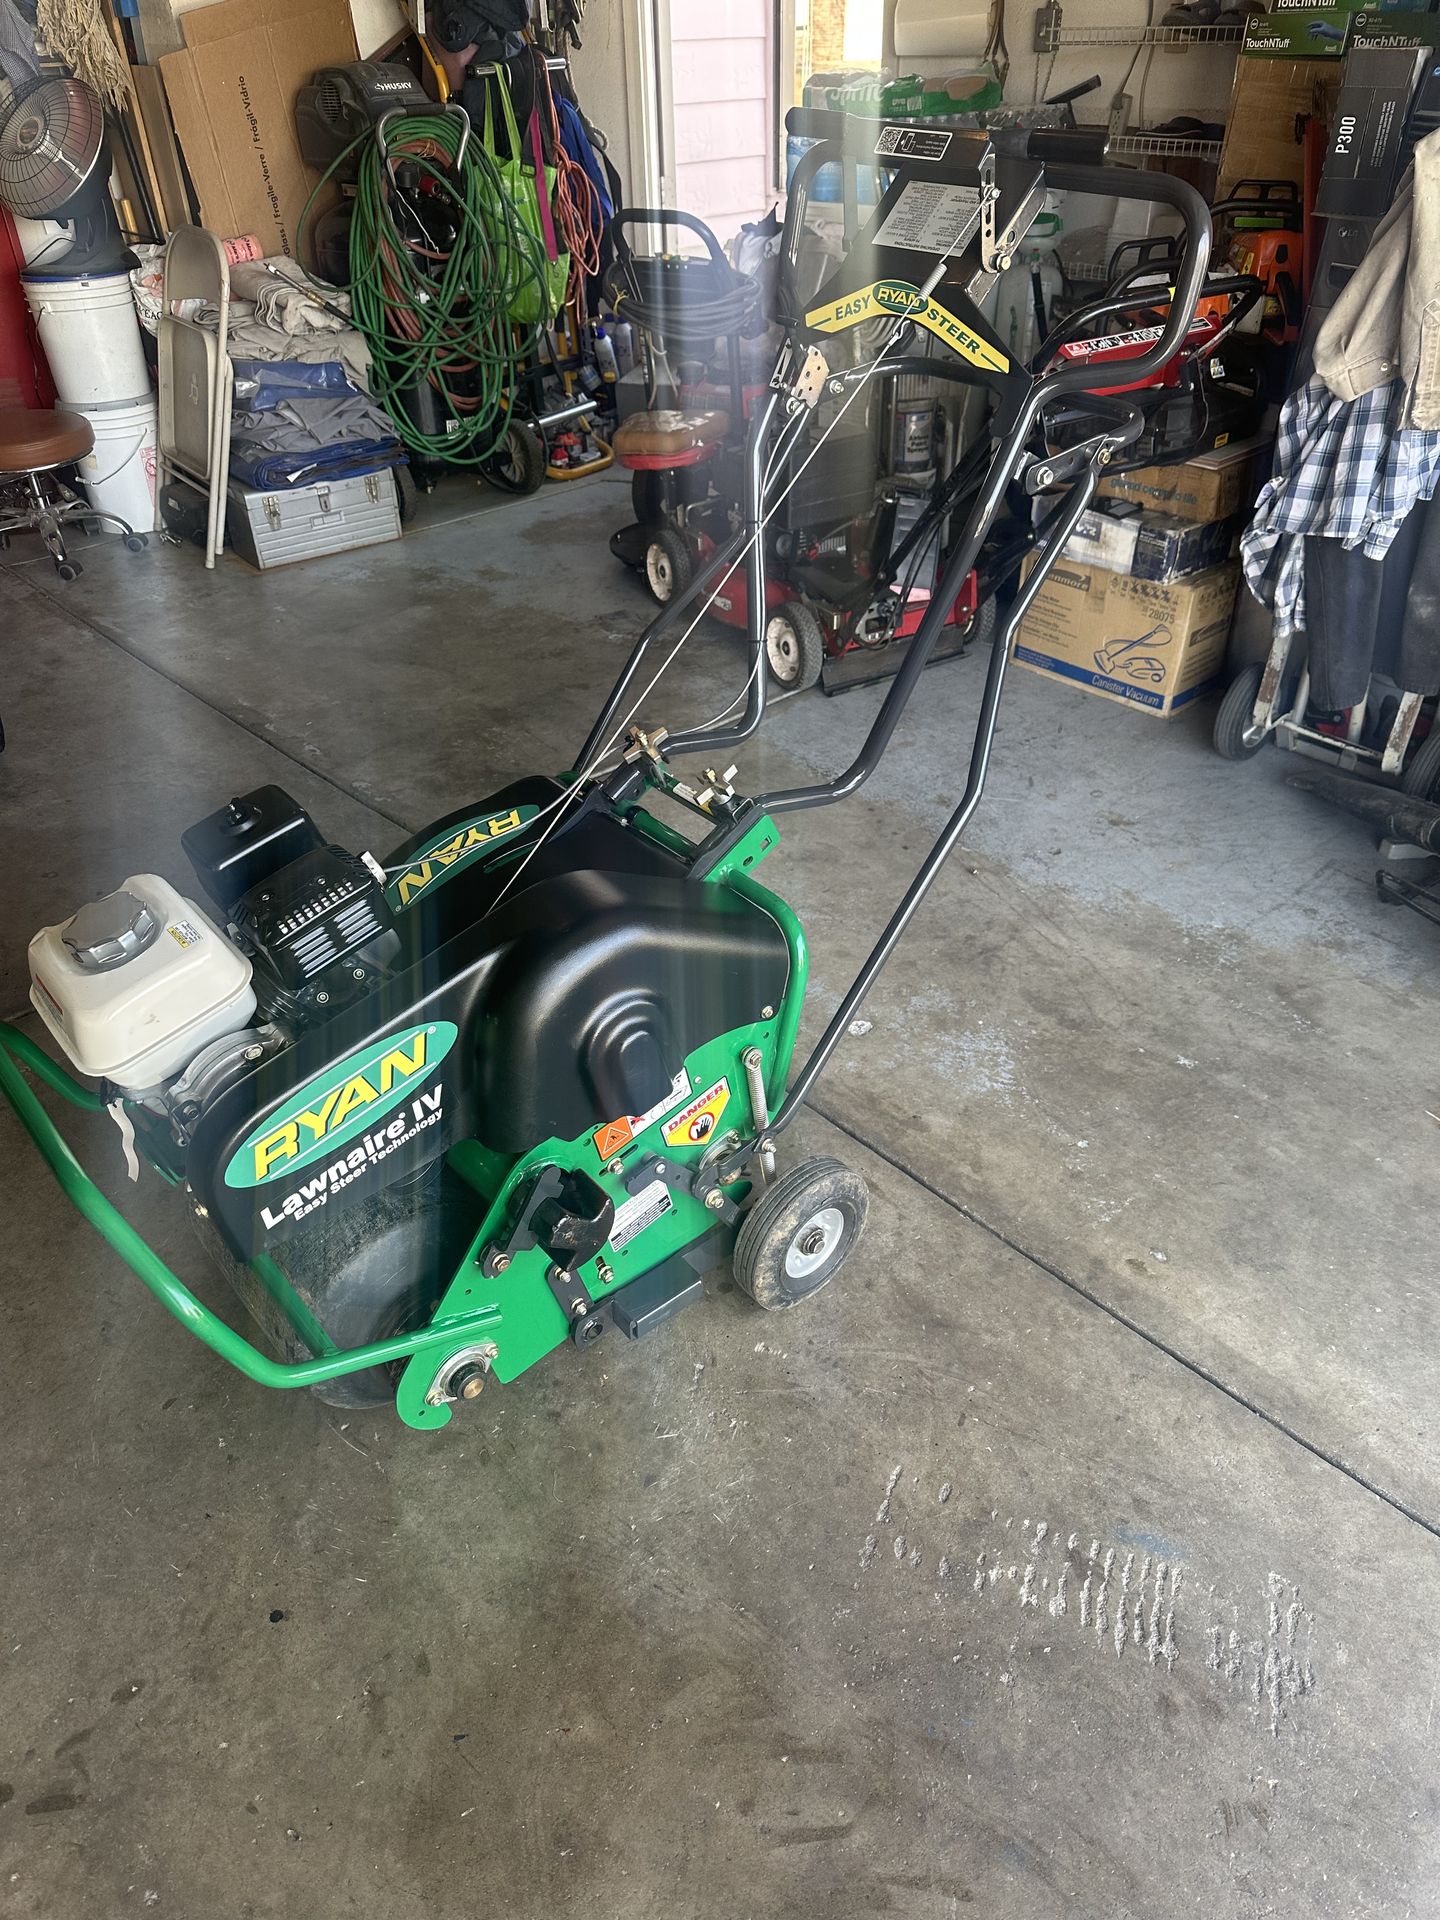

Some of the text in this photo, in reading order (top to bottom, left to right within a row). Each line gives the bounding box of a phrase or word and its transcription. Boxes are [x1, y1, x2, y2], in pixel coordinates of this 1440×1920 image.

[1246, 38, 1290, 48] TouchNTuff
[1353, 35, 1423, 48] TouchNTuff
[383, 81, 412, 91] HUSKY
[238, 75, 261, 143] Frágil-Vidrio
[1335, 116, 1357, 154] P300
[259, 153, 282, 218] Fragile-Verre
[835, 294, 871, 321] EASY
[877, 286, 921, 308] RYAN
[927, 308, 981, 355] STEER
[1148, 608, 1175, 624] 28075
[1091, 674, 1159, 706] Canister Vacuum
[398, 809, 521, 905] RYAN
[254, 1031, 428, 1181] RYAN
[668, 1084, 724, 1132] DANGER
[260, 1083, 443, 1230] Lawnaire IV
[294, 1108, 443, 1221] Easy Steer Technology
